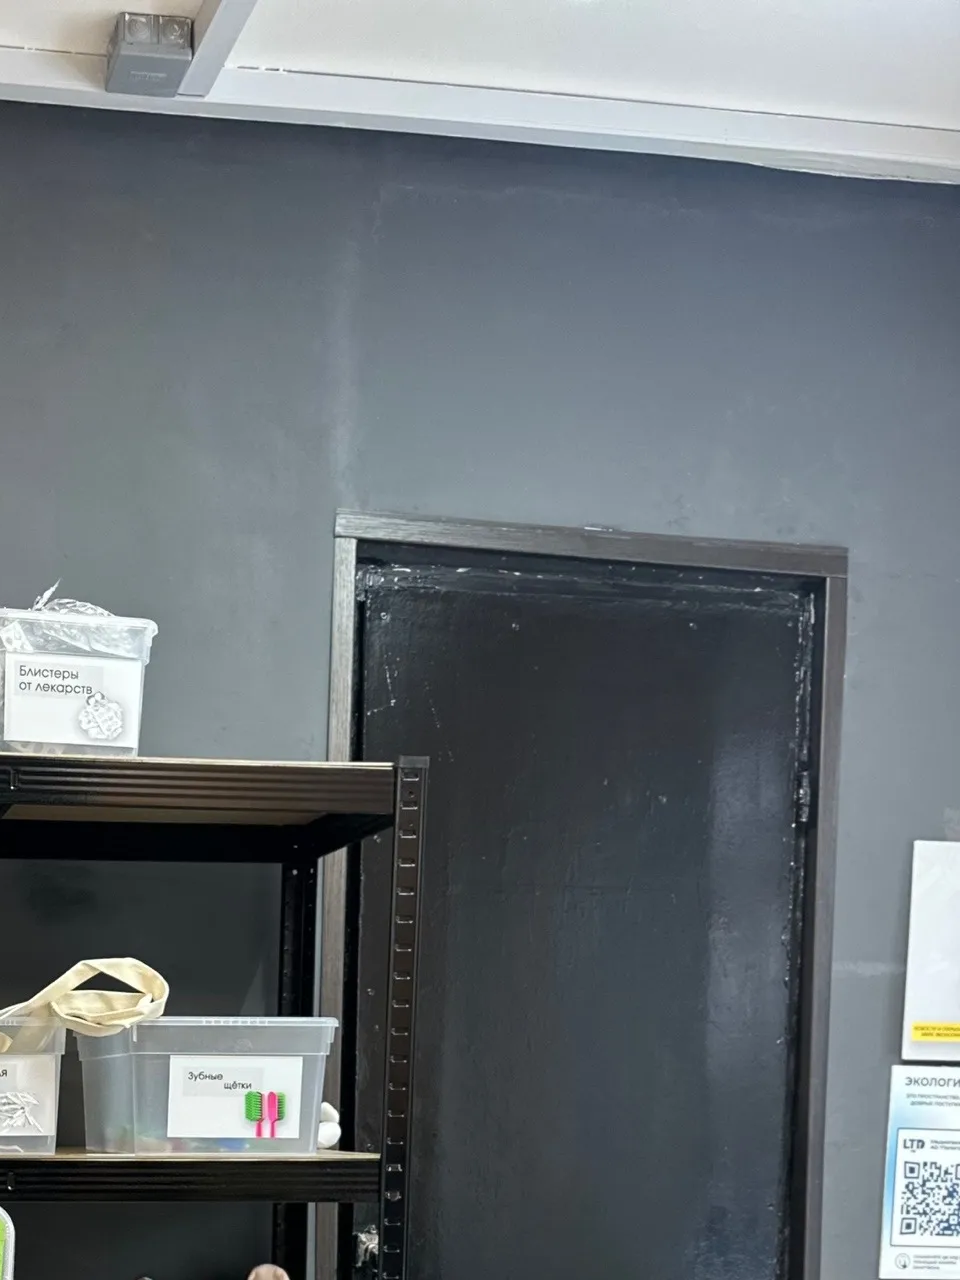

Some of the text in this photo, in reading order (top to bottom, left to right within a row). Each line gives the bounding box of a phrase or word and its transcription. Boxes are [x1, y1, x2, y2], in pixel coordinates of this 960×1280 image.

[19, 664, 79, 681] Блистеры
[19, 681, 93, 695] от лекарств
[188, 1071, 223, 1081] Зубные
[224, 1081, 252, 1090] щётки
